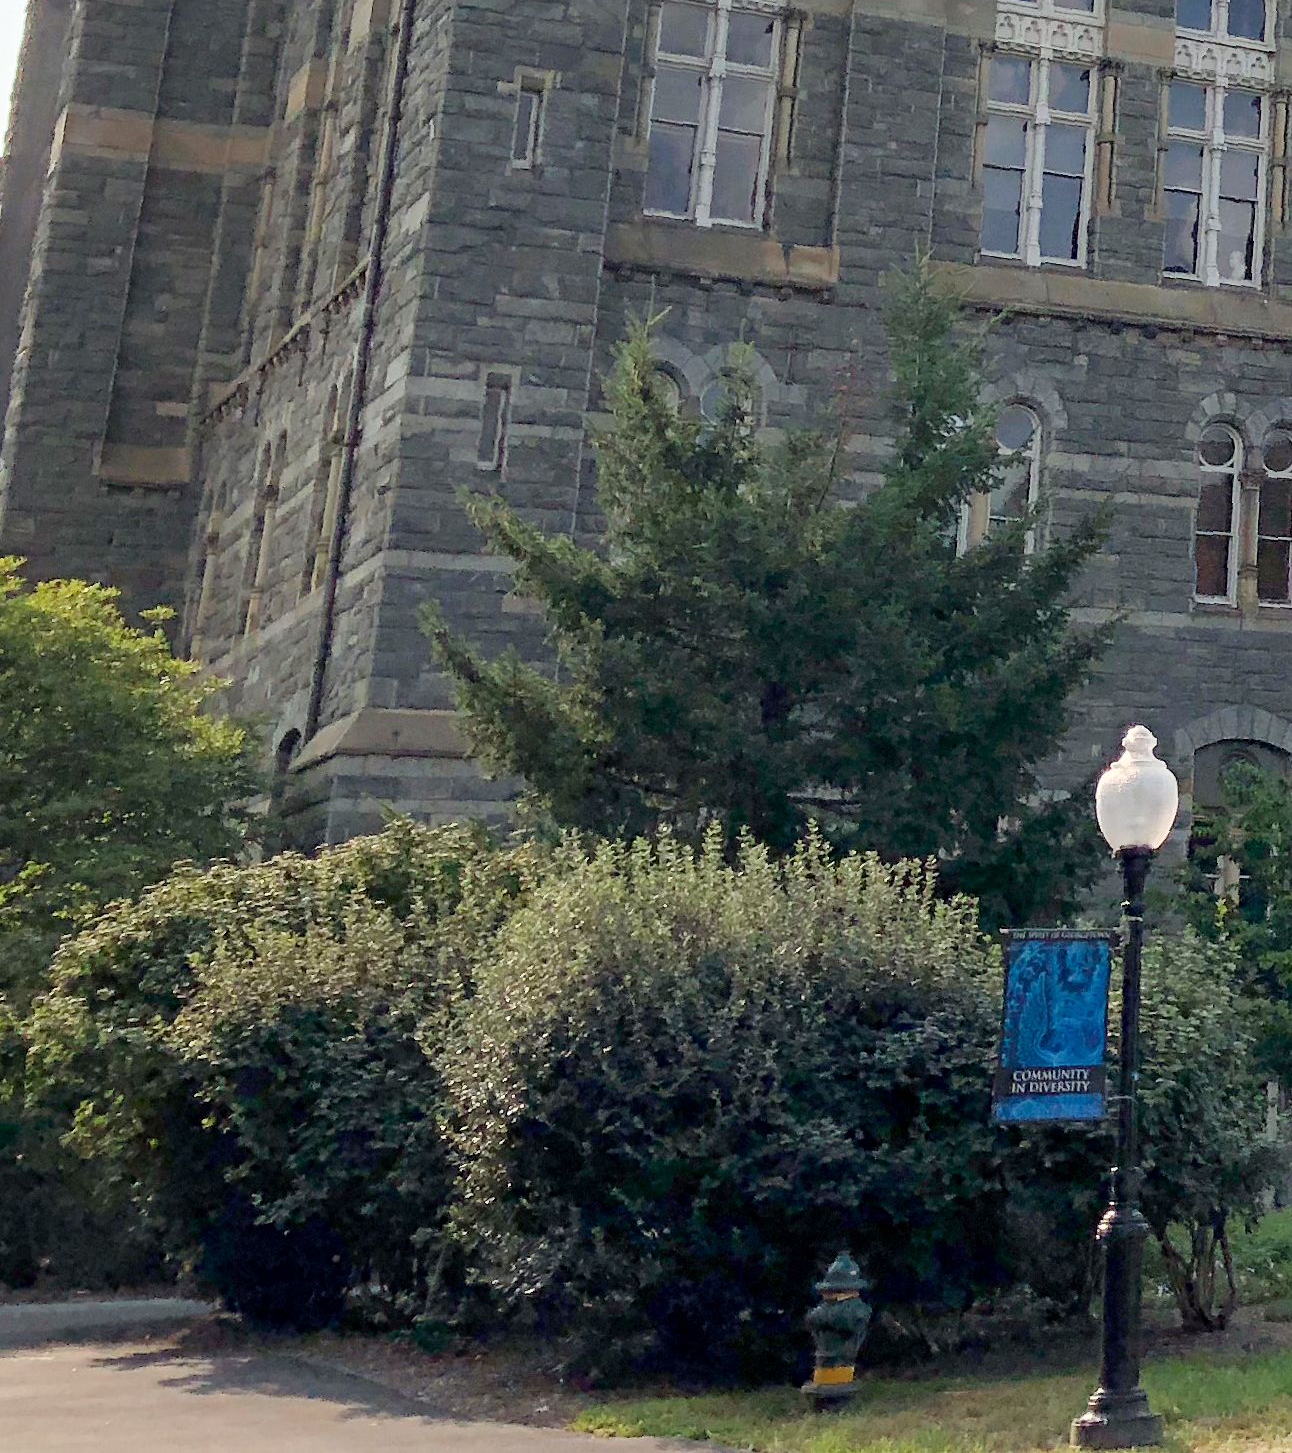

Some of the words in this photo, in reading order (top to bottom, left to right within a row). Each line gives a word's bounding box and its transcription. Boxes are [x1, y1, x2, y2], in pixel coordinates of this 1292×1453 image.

[1013, 1069, 1089, 1081] COMMUNITY
[1011, 1082, 1026, 1093] IN
[1029, 1081, 1090, 1092] DIVERSITY
